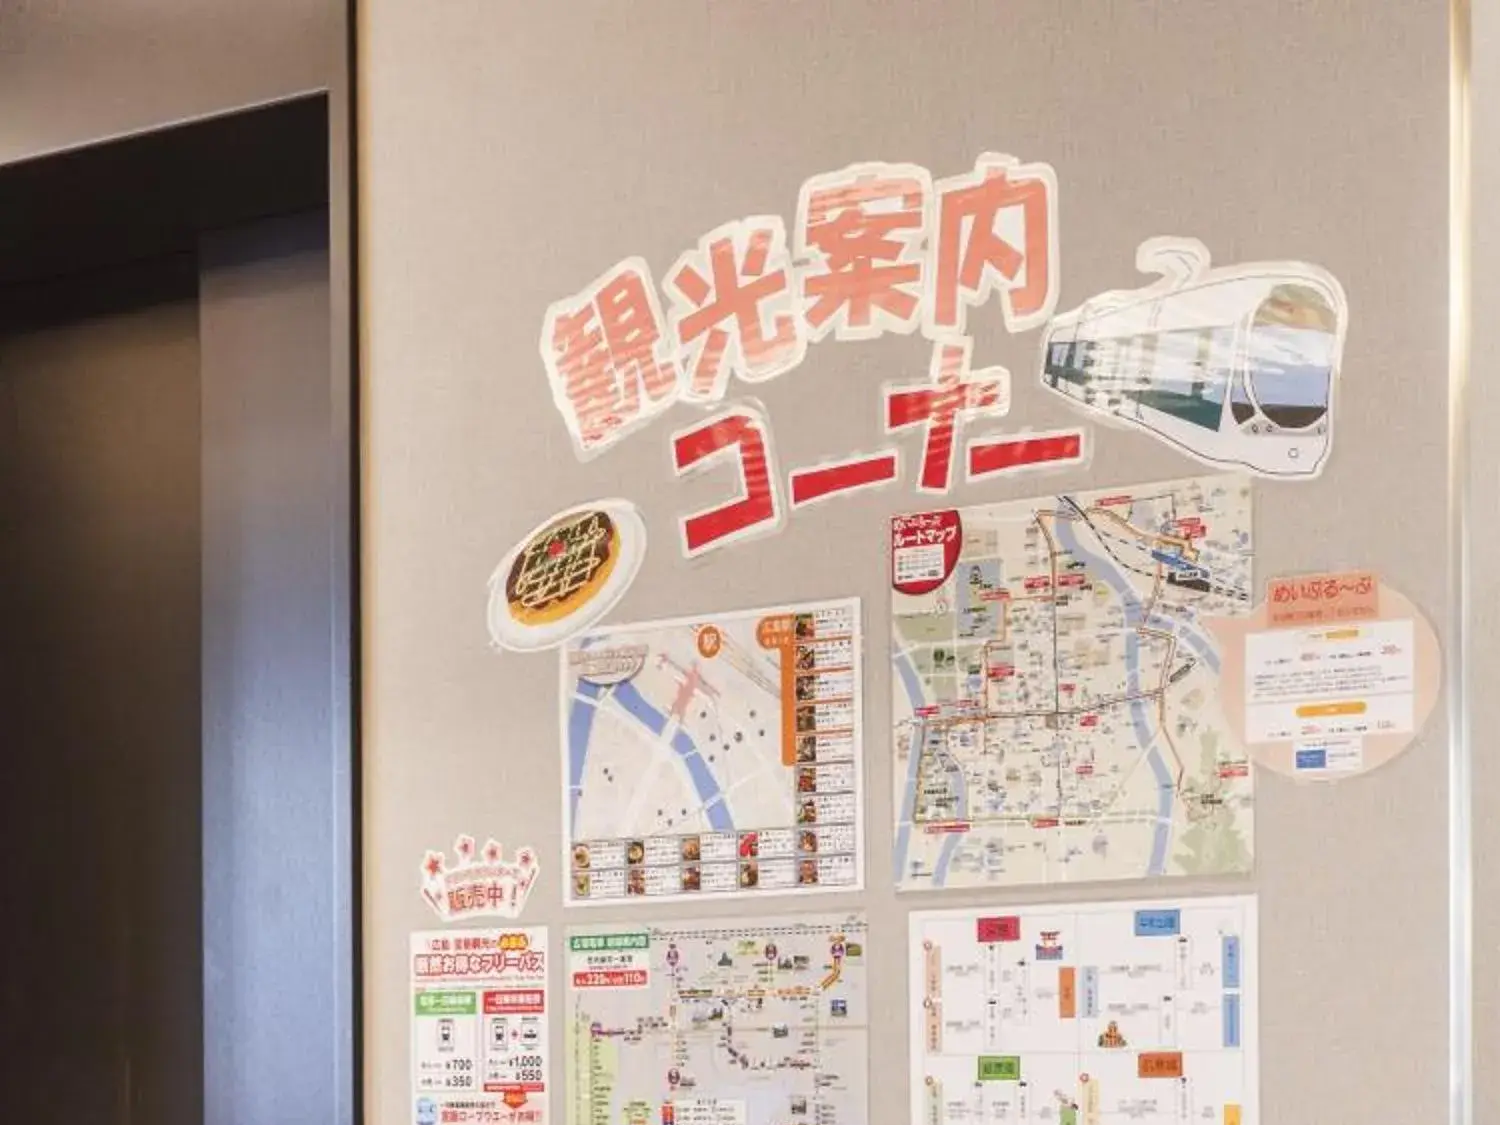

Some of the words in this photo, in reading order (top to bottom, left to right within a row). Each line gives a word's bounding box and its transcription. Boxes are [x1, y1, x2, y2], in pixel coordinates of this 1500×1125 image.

[553, 165, 1050, 450] 観光案内
[673, 346, 1083, 552] コーナー
